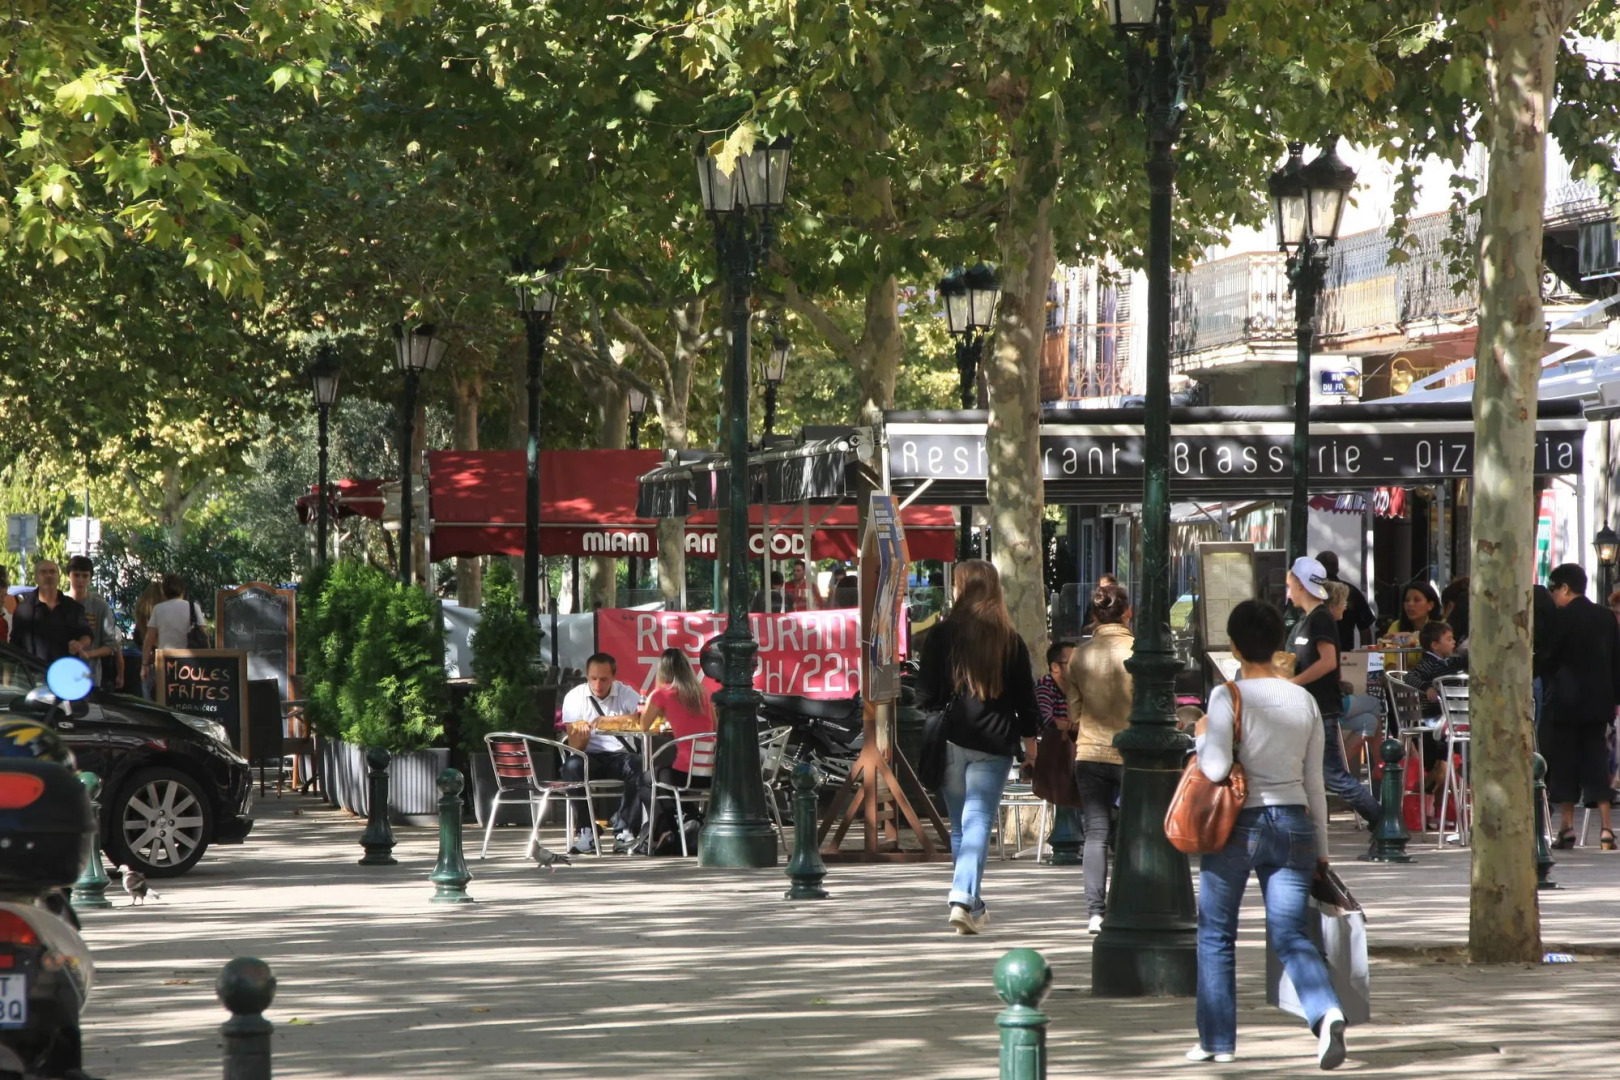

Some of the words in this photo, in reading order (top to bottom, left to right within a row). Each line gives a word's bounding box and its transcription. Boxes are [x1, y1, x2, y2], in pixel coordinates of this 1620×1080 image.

[1323, 383, 1333, 391] DU
[902, 441, 1121, 475] Restrant
[1174, 441, 1361, 474] Brassrie
[1416, 437, 1573, 473] Pizia
[582, 532, 649, 552] MIAM
[657, 532, 718, 553] AM
[748, 533, 805, 554] OOD
[637, 613, 862, 652] RESTURANT
[166, 661, 230, 681] MOULES
[168, 684, 230, 701] FRITES
